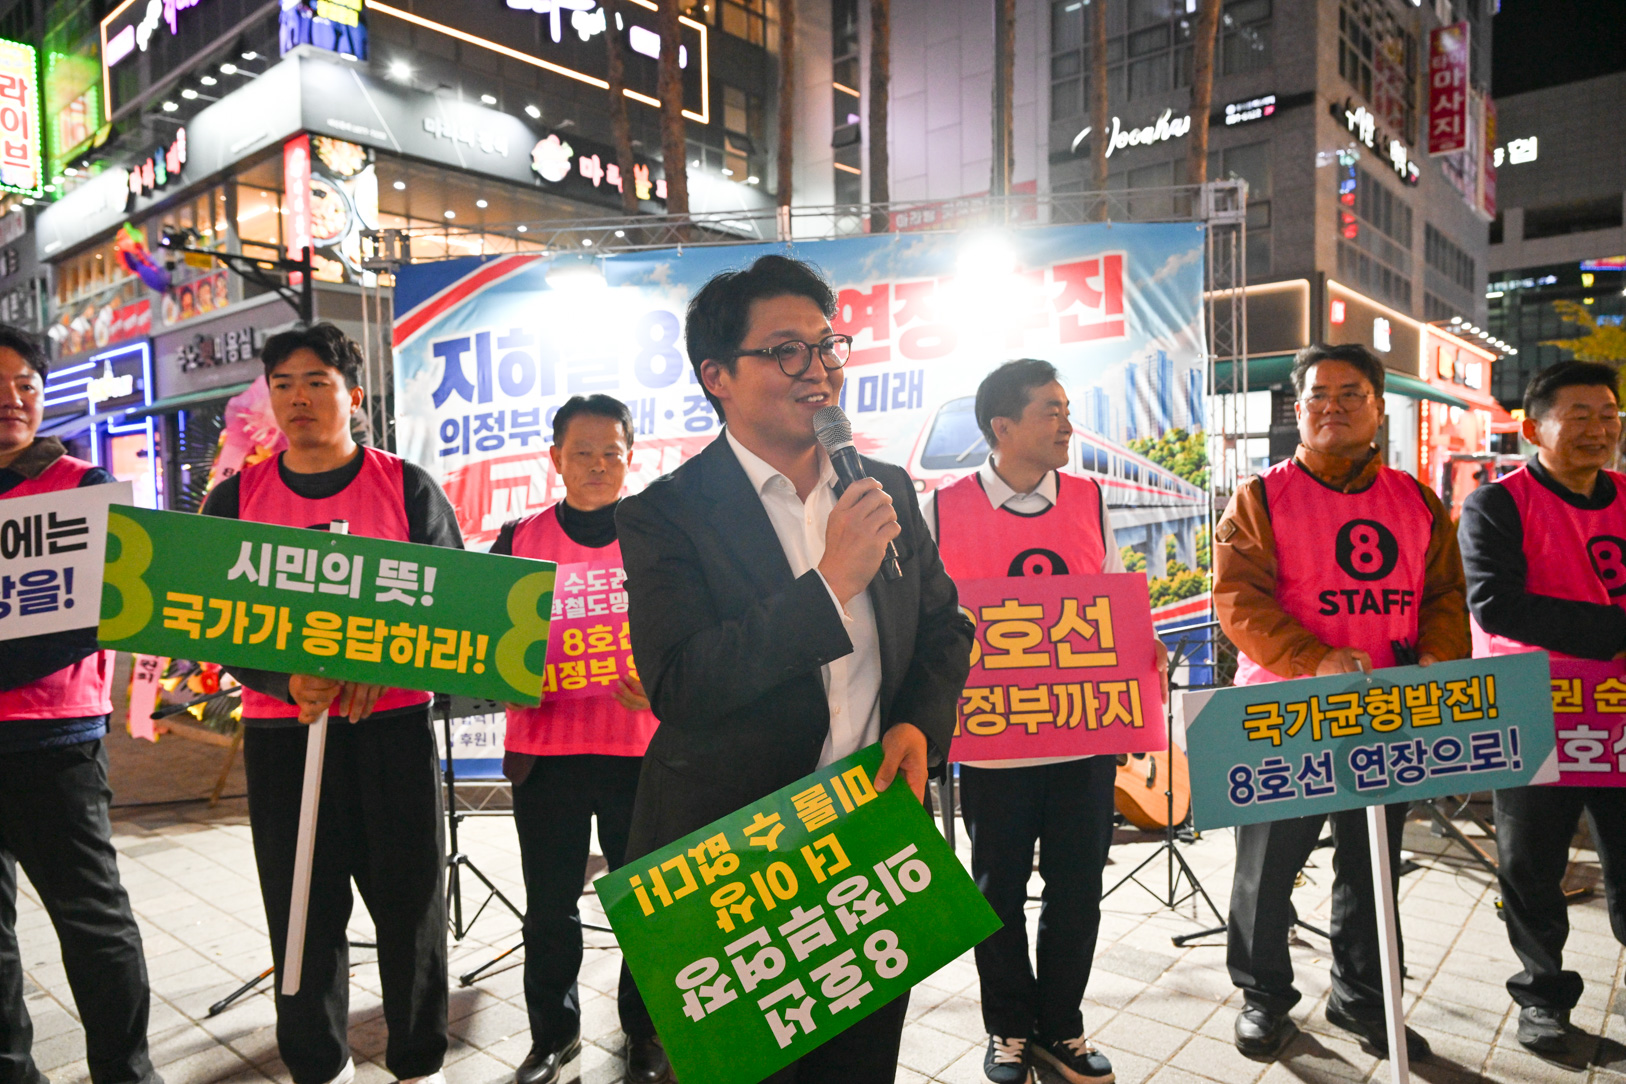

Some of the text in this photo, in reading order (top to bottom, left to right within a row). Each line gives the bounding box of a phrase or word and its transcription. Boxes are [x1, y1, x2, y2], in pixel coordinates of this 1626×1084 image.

[1433, 67, 1464, 137] 마사지
[682, 393, 724, 433] 경
[857, 368, 924, 414] 미래
[0, 511, 90, 560] 에는
[227, 541, 438, 608] 시민의 뜻!
[1318, 588, 1416, 617] STAFF
[162, 591, 490, 675] 국가가 응답하라!
[460, 732, 487, 748] 후원
[952, 677, 1145, 738] 정부까지
[1242, 673, 1499, 747] 국가균형발전!
[1227, 725, 1524, 807] 8호선 연장으로!
[628, 764, 878, 918] 미룰 수 없다!
[710, 832, 852, 934] 더 이상
[674, 842, 932, 1023] 의정부연장
[757, 928, 909, 1050] 8호선
